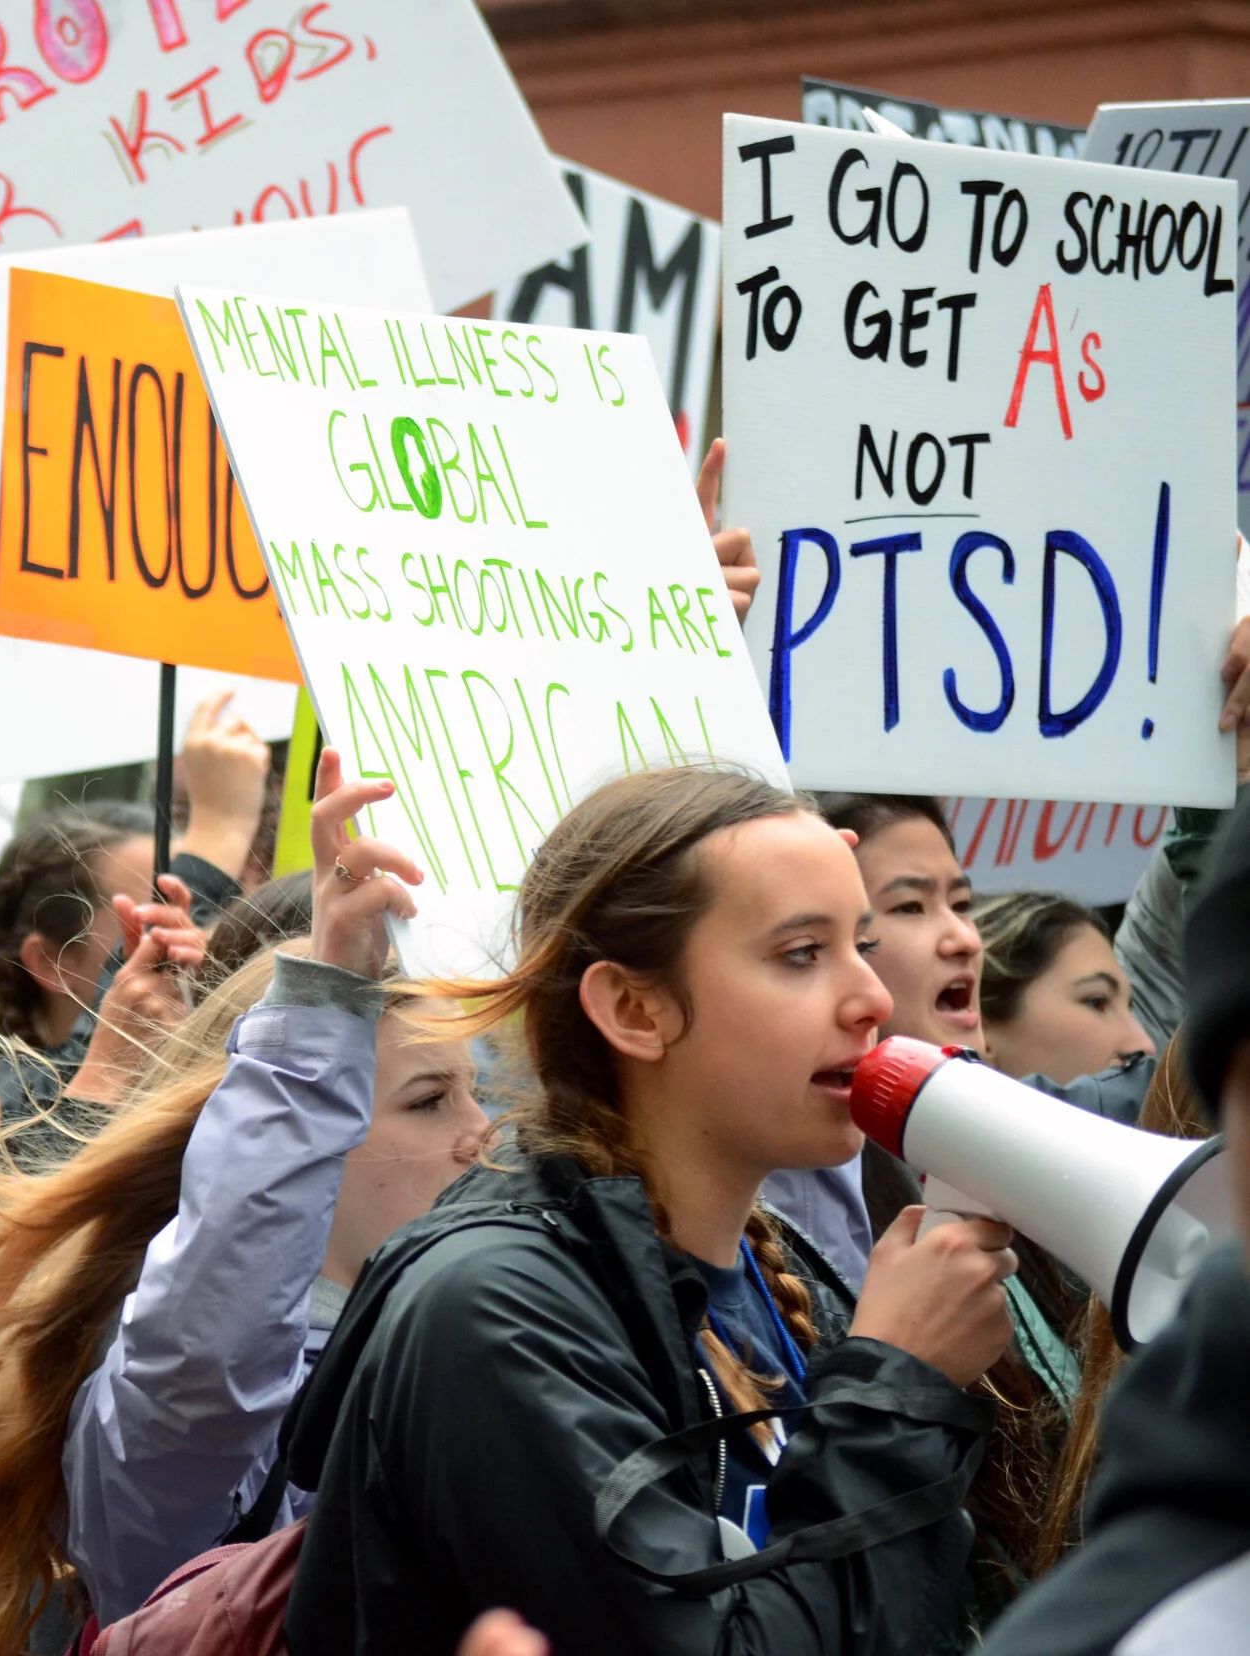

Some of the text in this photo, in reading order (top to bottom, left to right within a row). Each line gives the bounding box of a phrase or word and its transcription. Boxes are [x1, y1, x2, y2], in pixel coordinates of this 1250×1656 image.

[736, 134, 795, 240] I
[827, 146, 930, 253] GO
[959, 179, 1029, 274] TO
[1055, 190, 1236, 299] SCHOOL
[195, 296, 627, 408] MENTAL ILLNESS IS
[735, 265, 803, 361] TO
[843, 279, 978, 383] GET
[327, 409, 549, 530] GLOBAL
[854, 423, 991, 506] NOT
[269, 538, 734, 658] MASS SHOOTINGS ARE
[768, 480, 1171, 764] PTSD!
